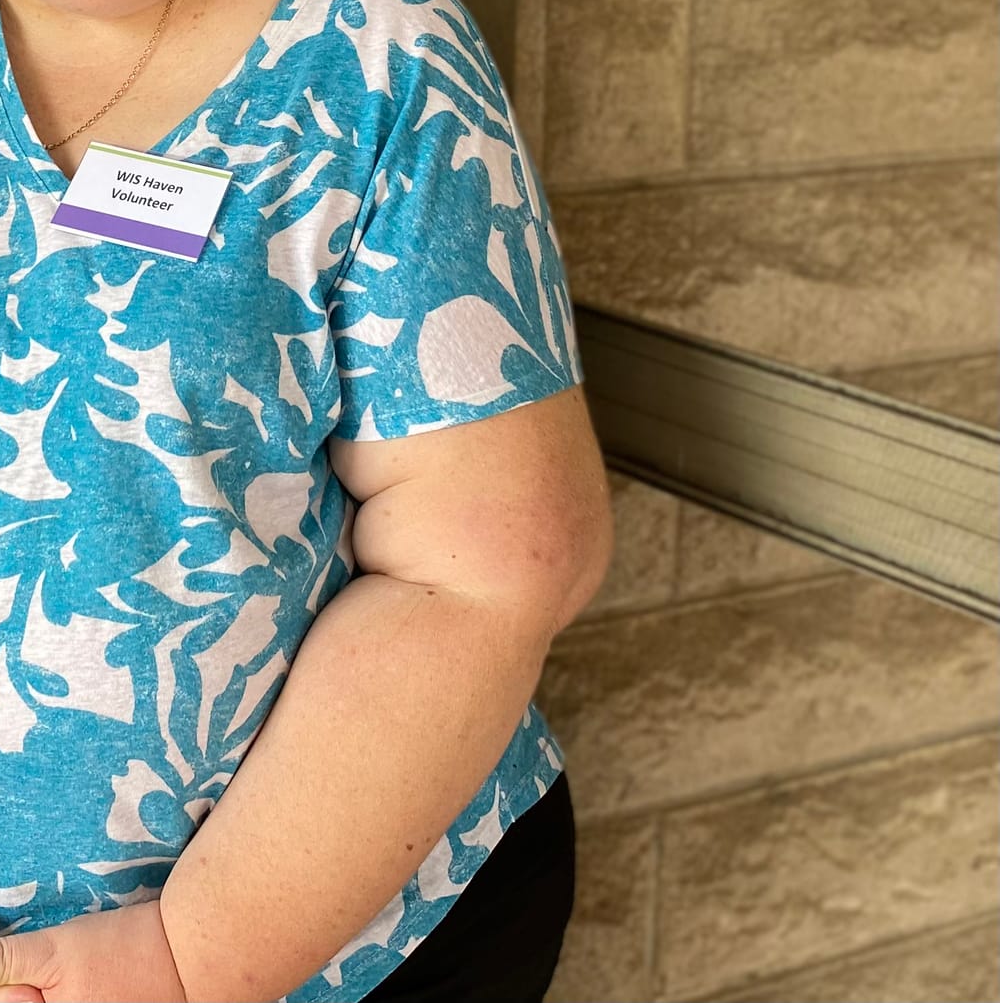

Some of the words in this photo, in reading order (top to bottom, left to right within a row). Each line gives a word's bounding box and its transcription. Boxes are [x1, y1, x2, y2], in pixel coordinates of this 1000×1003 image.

[116, 170, 142, 186] WIS
[143, 176, 185, 195] Haven
[111, 187, 174, 212] Volunteer
